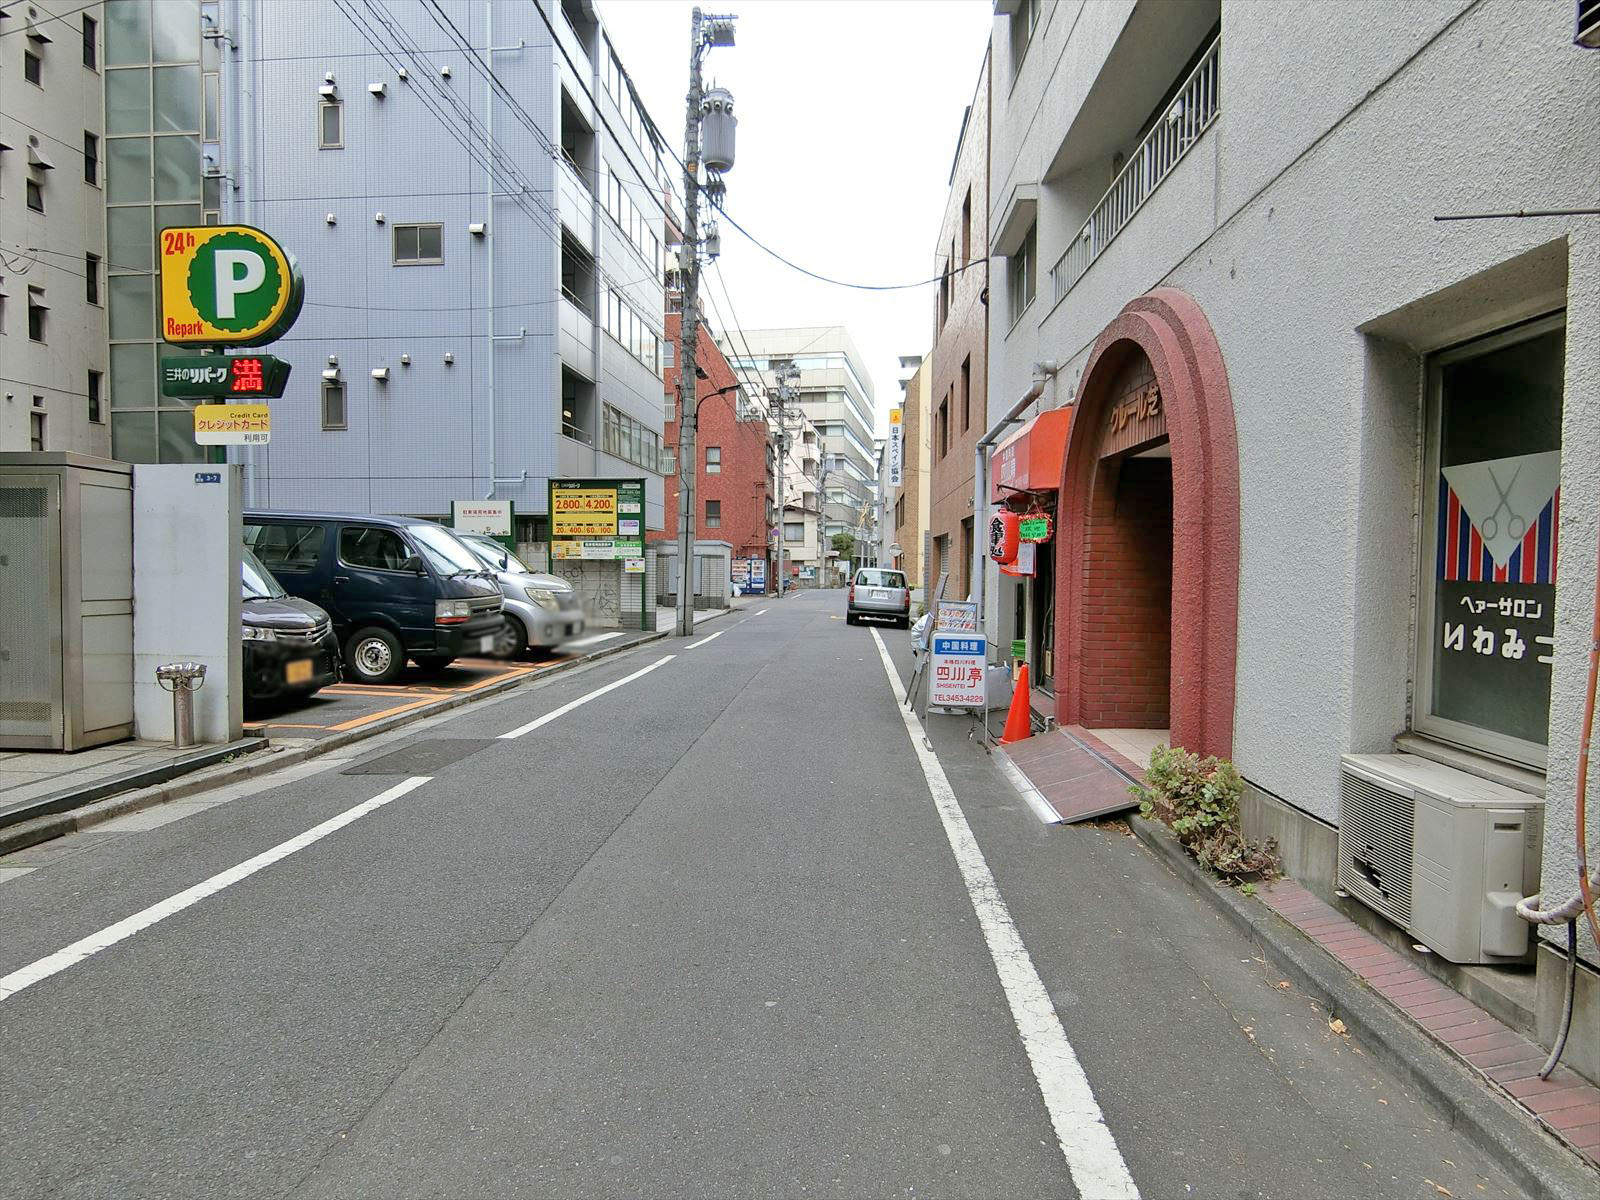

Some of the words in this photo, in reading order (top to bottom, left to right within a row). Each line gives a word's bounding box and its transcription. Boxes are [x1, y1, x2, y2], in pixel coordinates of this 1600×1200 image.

[165, 232, 195, 255] 24h
[214, 249, 266, 319] P
[167, 317, 204, 337] Repark
[166, 366, 227, 384] 三井のリパーク
[231, 358, 264, 391] 満
[1109, 384, 1159, 434] クレール芝
[198, 420, 269, 430] クレジットカード
[244, 433, 269, 442] 利用可
[891, 426, 899, 483] 日本スペイン協会
[990, 517, 1005, 557] 食事処
[942, 641, 978, 651] 中国料理
[936, 666, 982, 688] 四川亭
